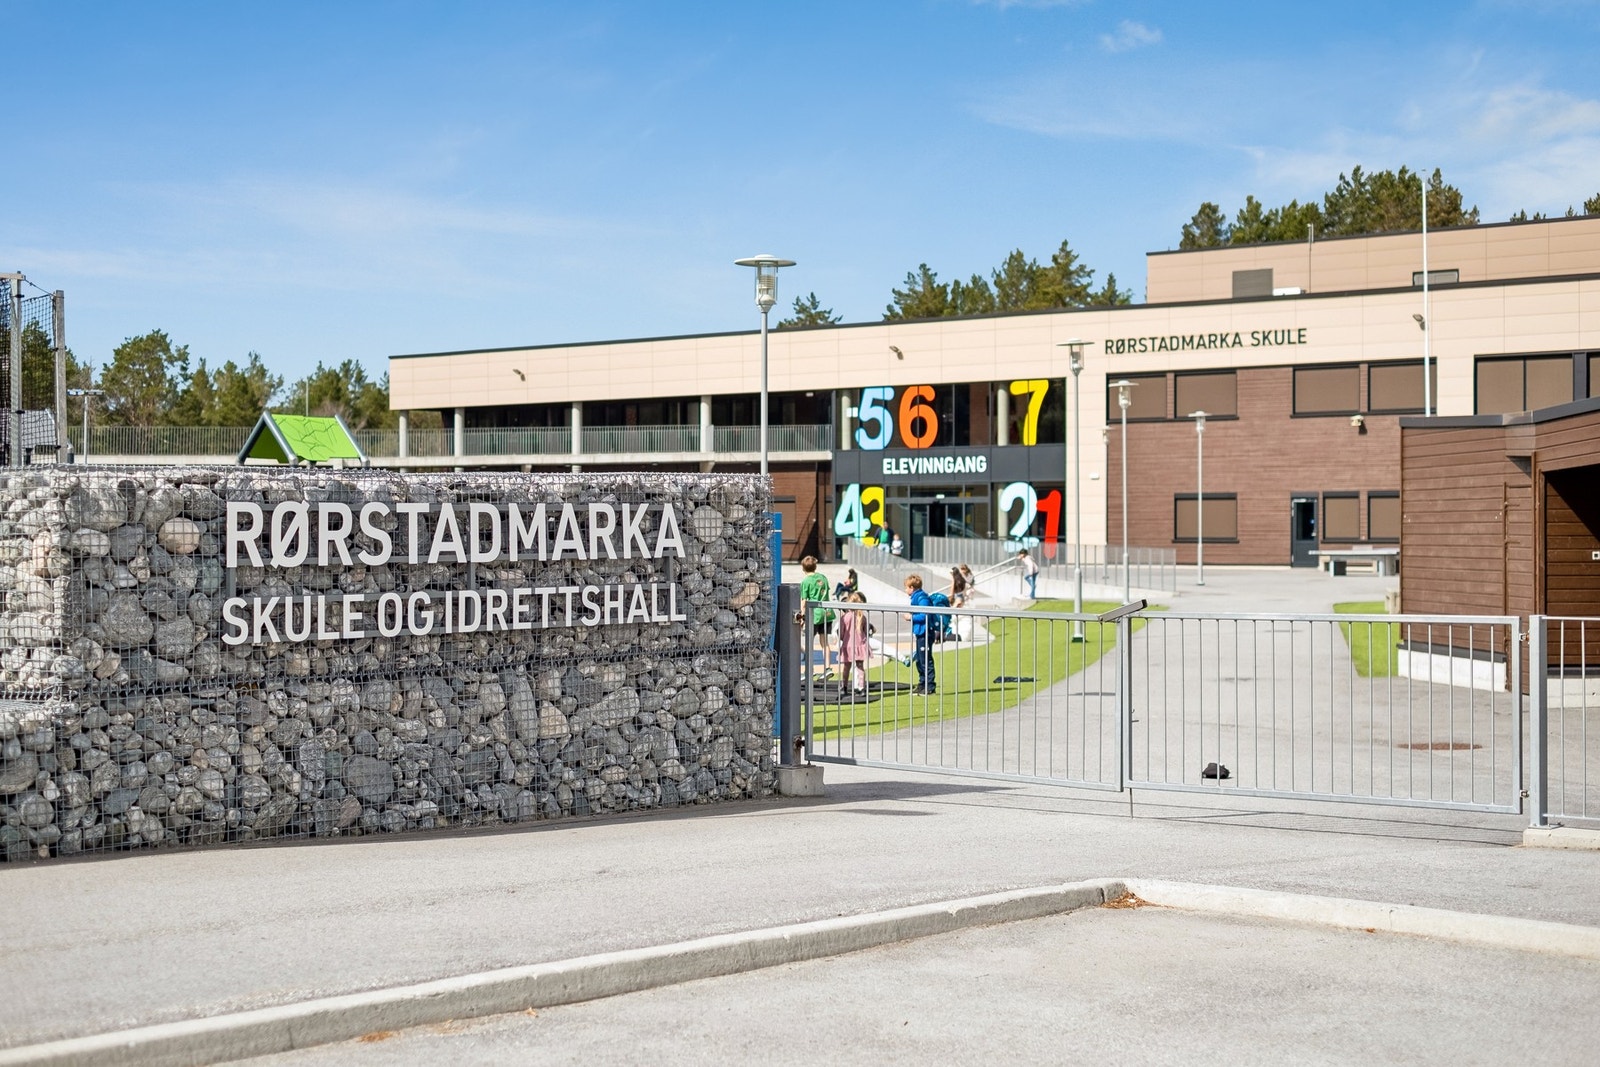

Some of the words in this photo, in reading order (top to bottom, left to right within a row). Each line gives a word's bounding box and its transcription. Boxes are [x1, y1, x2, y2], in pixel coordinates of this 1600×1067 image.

[1105, 331, 1243, 355] RØRSTADMARKA
[1251, 328, 1308, 347] SKULE
[855, 386, 895, 450] 5
[899, 385, 938, 449] 6
[1009, 379, 1049, 446] 7
[882, 455, 988, 475] ELEVINNGANG
[226, 500, 687, 568] RØRSTADMARKA
[834, 483, 872, 540] 4
[1000, 482, 1040, 553] 2
[1036, 489, 1062, 559] 1
[221, 594, 366, 646] SKULE
[377, 591, 435, 638] OG
[445, 582, 688, 634] IDRETTSHALL
